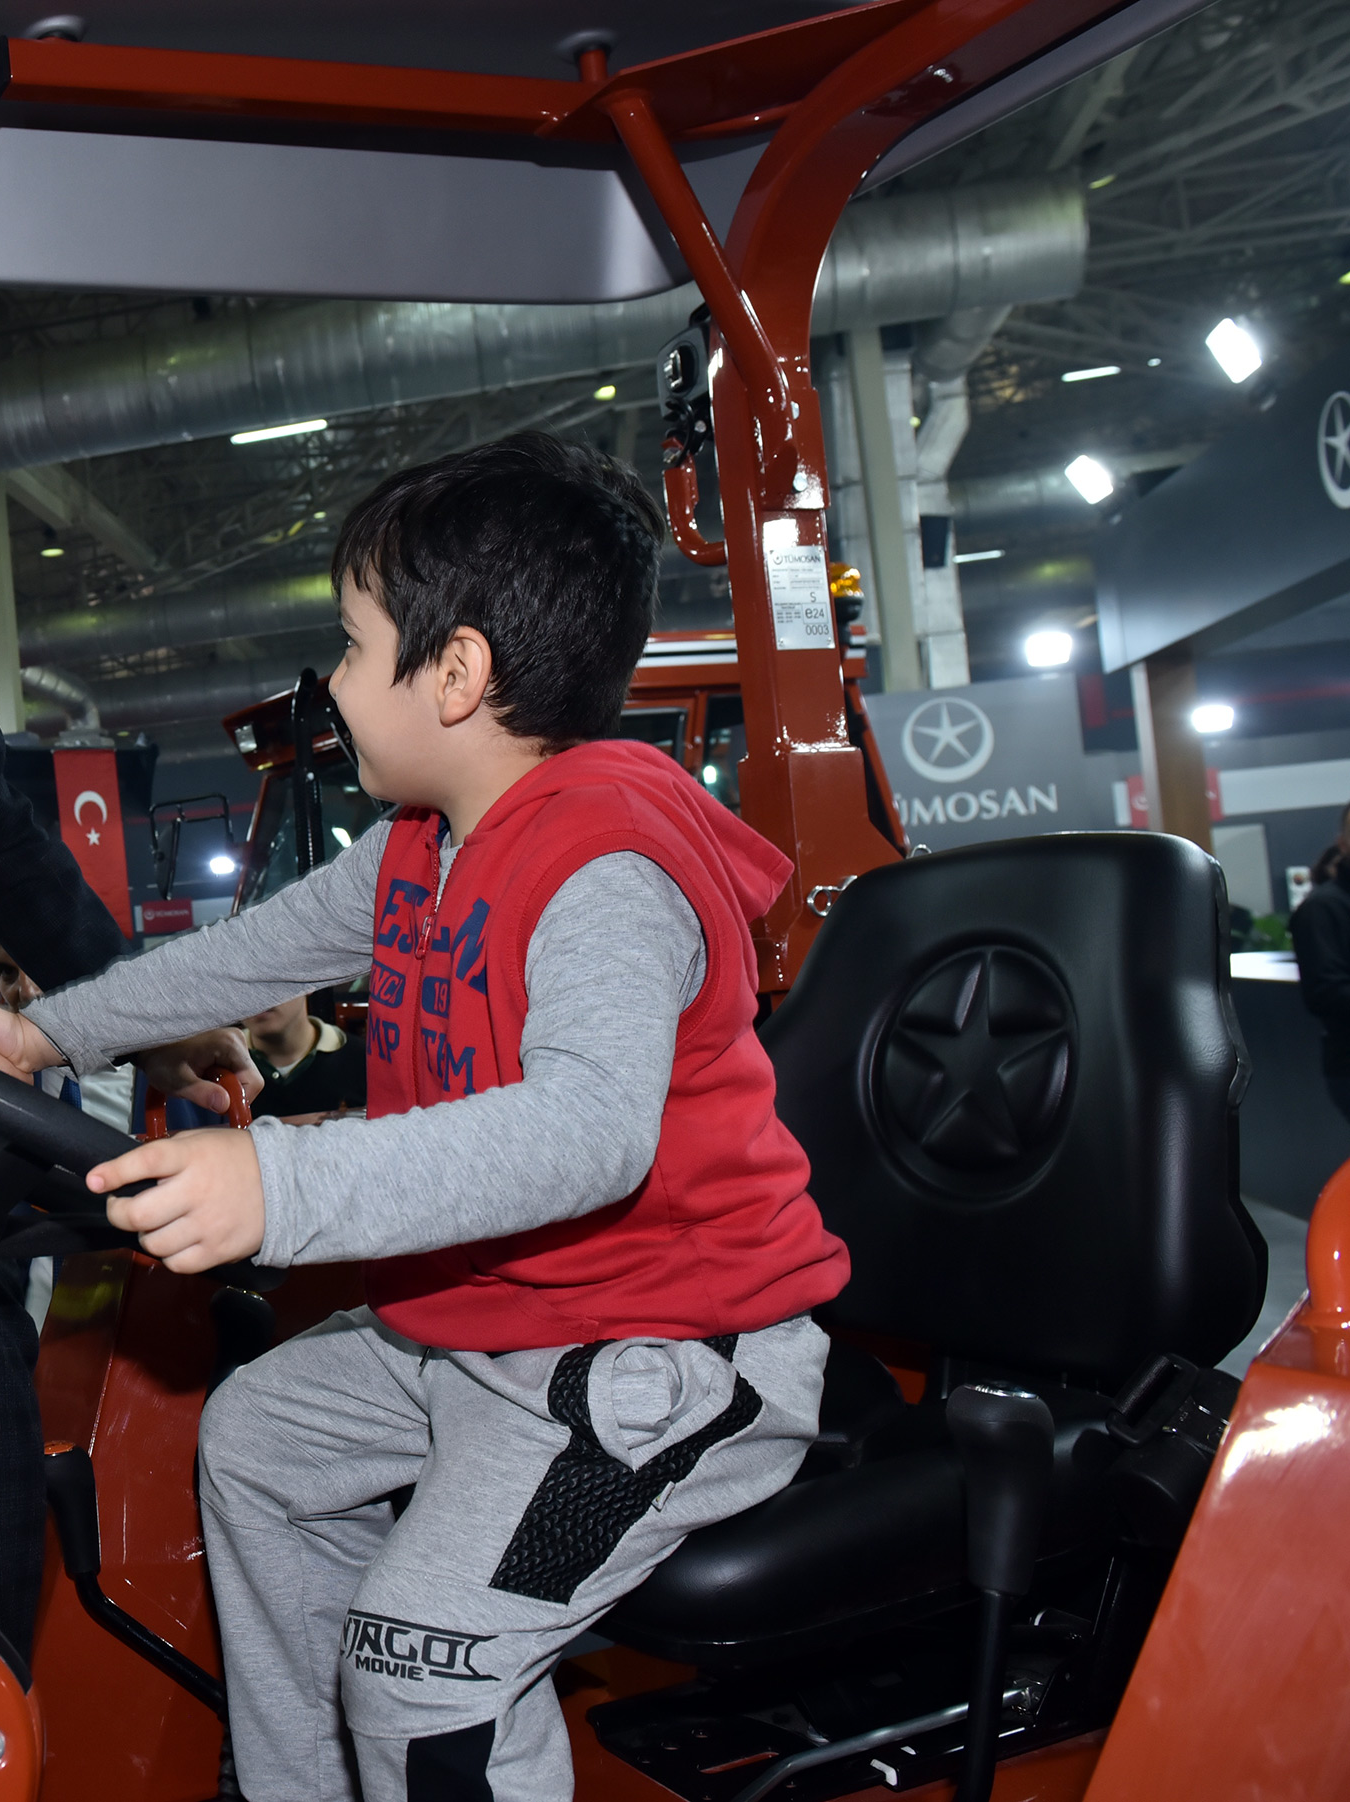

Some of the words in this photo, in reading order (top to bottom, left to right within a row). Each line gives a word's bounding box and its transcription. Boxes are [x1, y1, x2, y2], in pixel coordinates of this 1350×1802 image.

[784, 554, 821, 565] TÜMOSAN
[809, 592, 817, 603] S
[805, 607, 825, 619] e24
[805, 624, 830, 636] 0003
[355, 1654, 425, 1682] MOVIE
